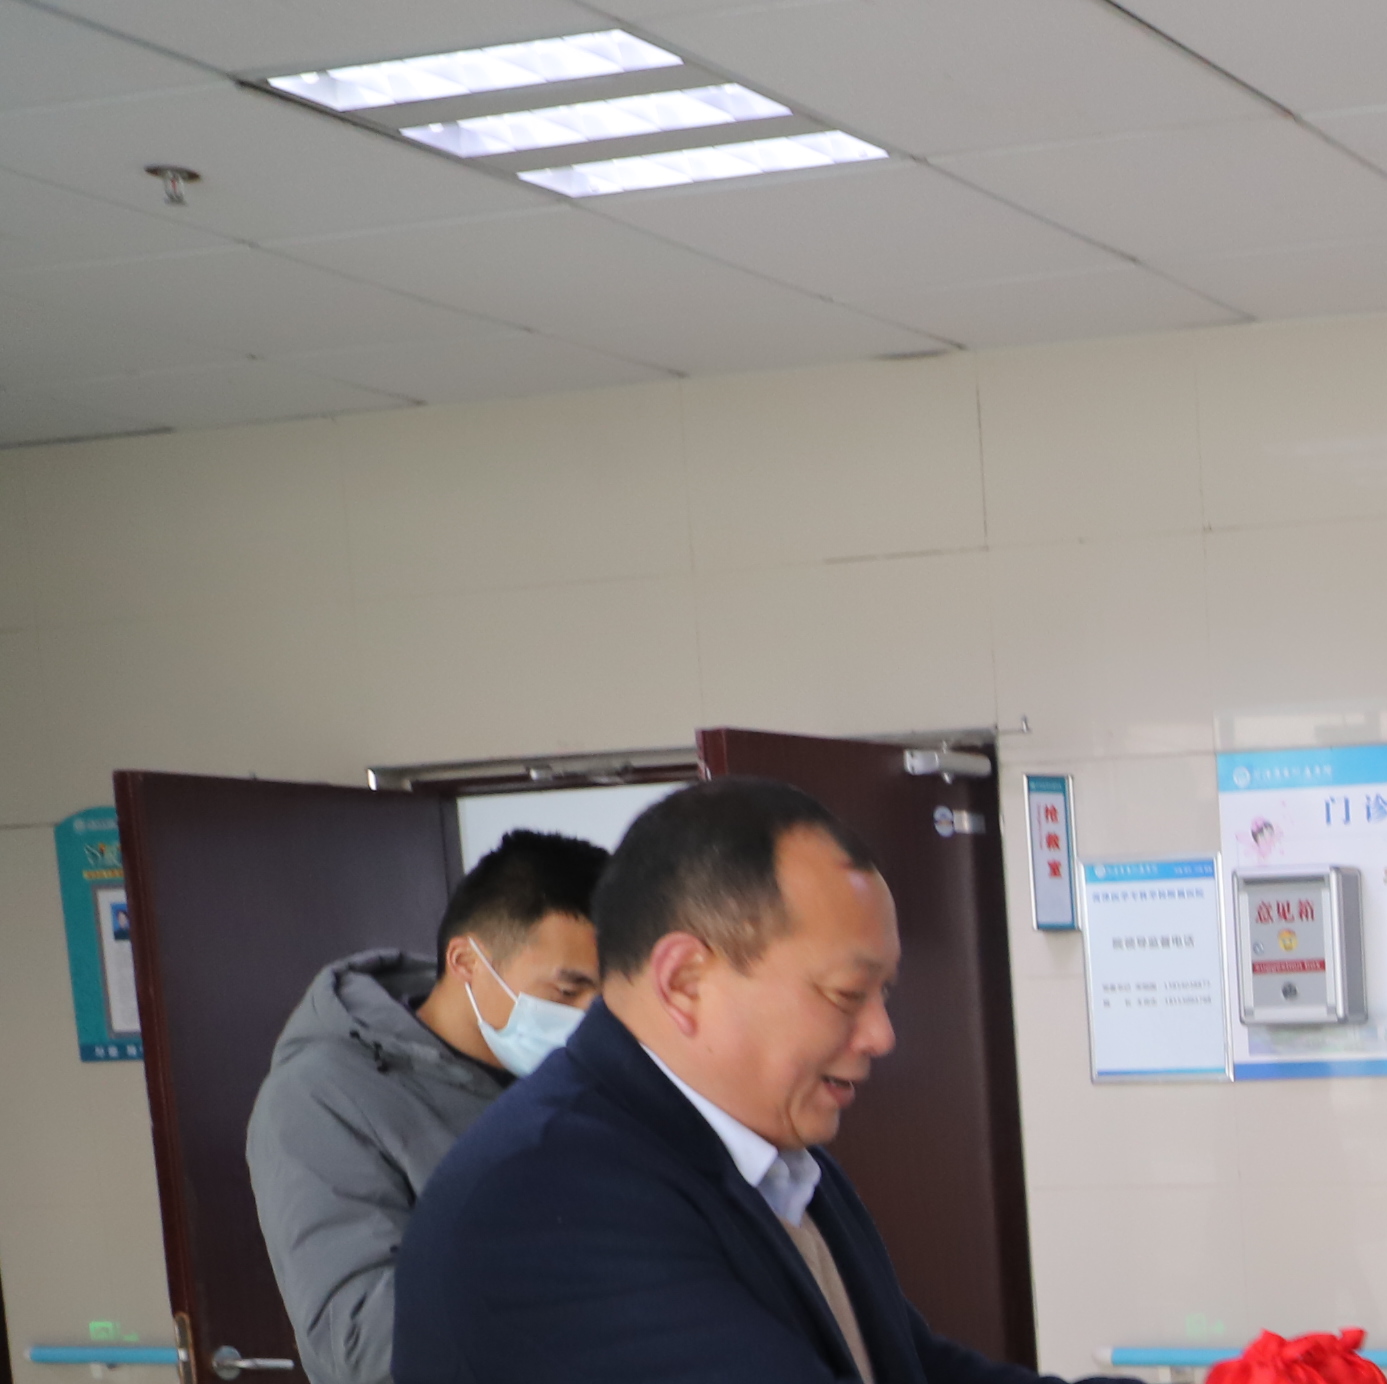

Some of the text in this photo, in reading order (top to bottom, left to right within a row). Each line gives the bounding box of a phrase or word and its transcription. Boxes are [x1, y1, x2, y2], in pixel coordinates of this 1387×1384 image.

[1044, 804, 1063, 879] 抢救室
[1255, 898, 1315, 924] 意见箱
